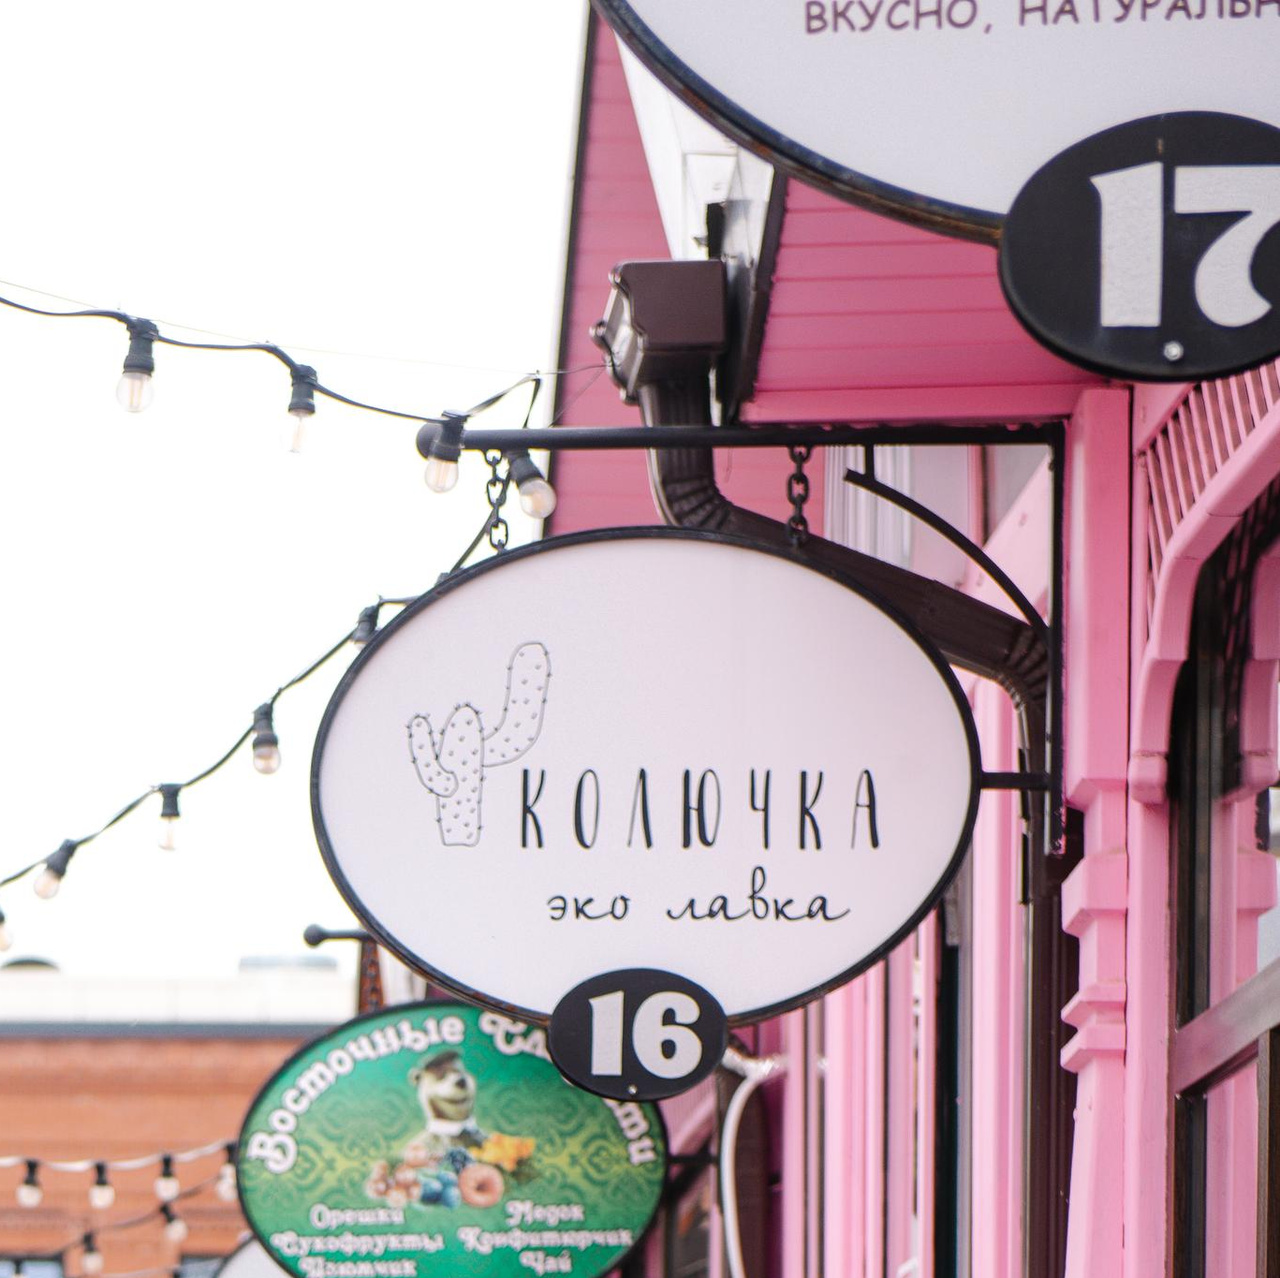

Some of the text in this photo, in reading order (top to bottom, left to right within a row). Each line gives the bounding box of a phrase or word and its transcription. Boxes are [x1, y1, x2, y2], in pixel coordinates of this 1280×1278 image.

[805, 0, 992, 34] ВКУСНО,
[1090, 162, 1280, 328] 17
[521, 769, 880, 850] КОЛЮЧКА
[547, 866, 851, 921] эко лавка
[588, 990, 703, 1079] 16
[247, 1015, 465, 1174] Восточные
